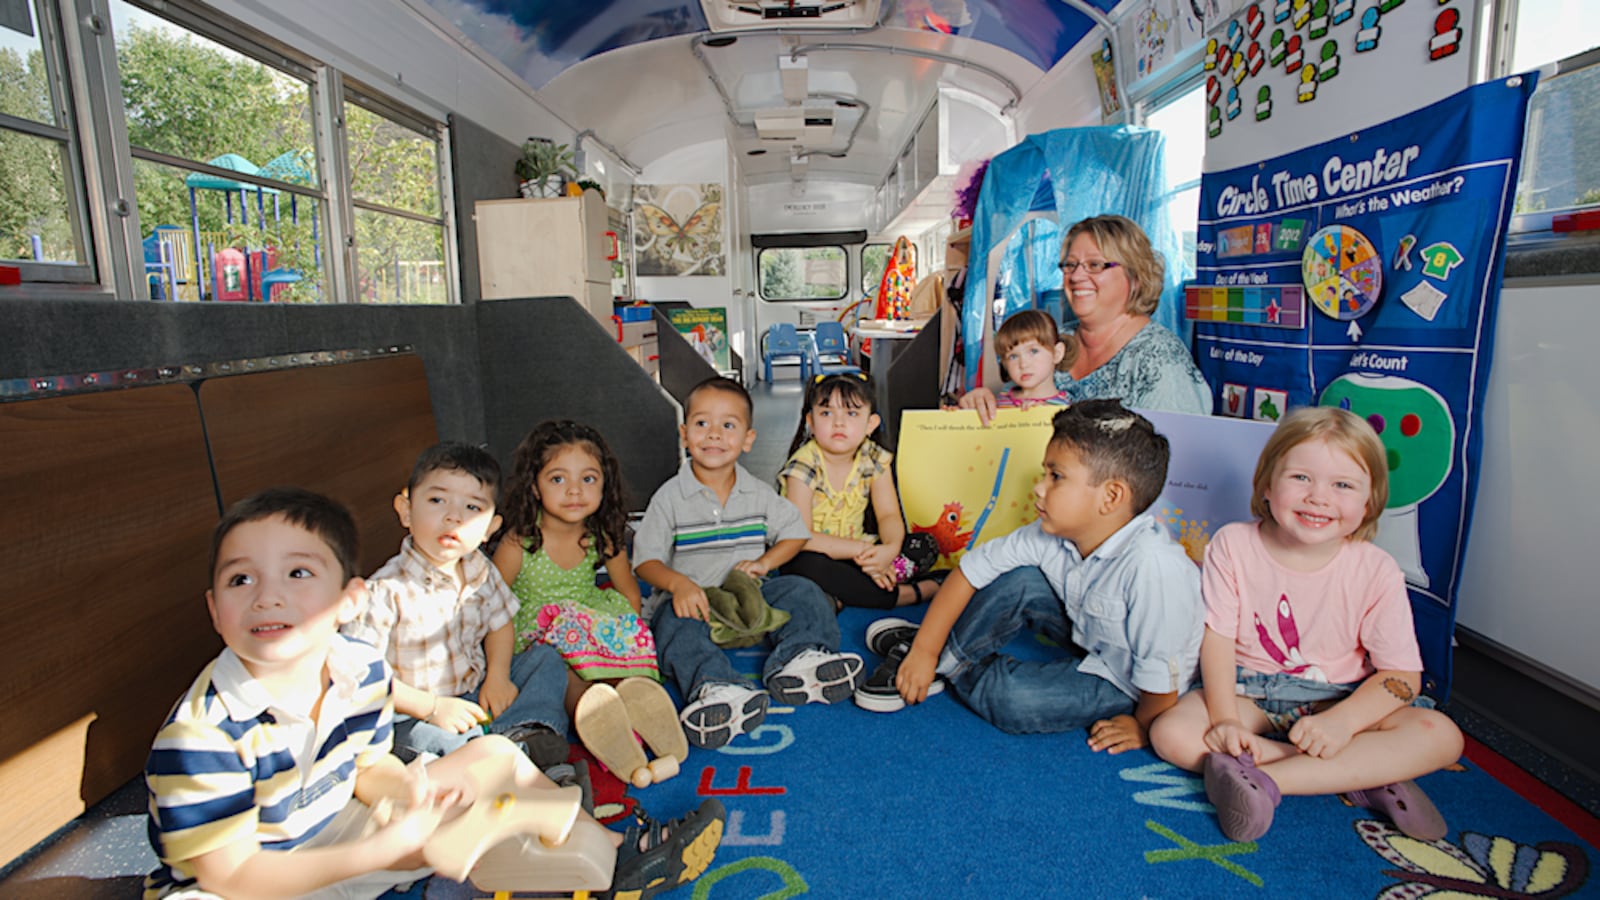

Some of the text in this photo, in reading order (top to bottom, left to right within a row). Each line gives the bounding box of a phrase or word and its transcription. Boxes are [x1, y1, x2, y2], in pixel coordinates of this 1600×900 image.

[1217, 145, 1420, 217] Circle Time Center
[1335, 176, 1465, 219] What's the Weather?
[1280, 228, 1300, 241] 2012
[1433, 252, 1447, 268] 8
[1368, 353, 1408, 371] Count
[697, 765, 787, 796] F
[1144, 820, 1264, 888] X
